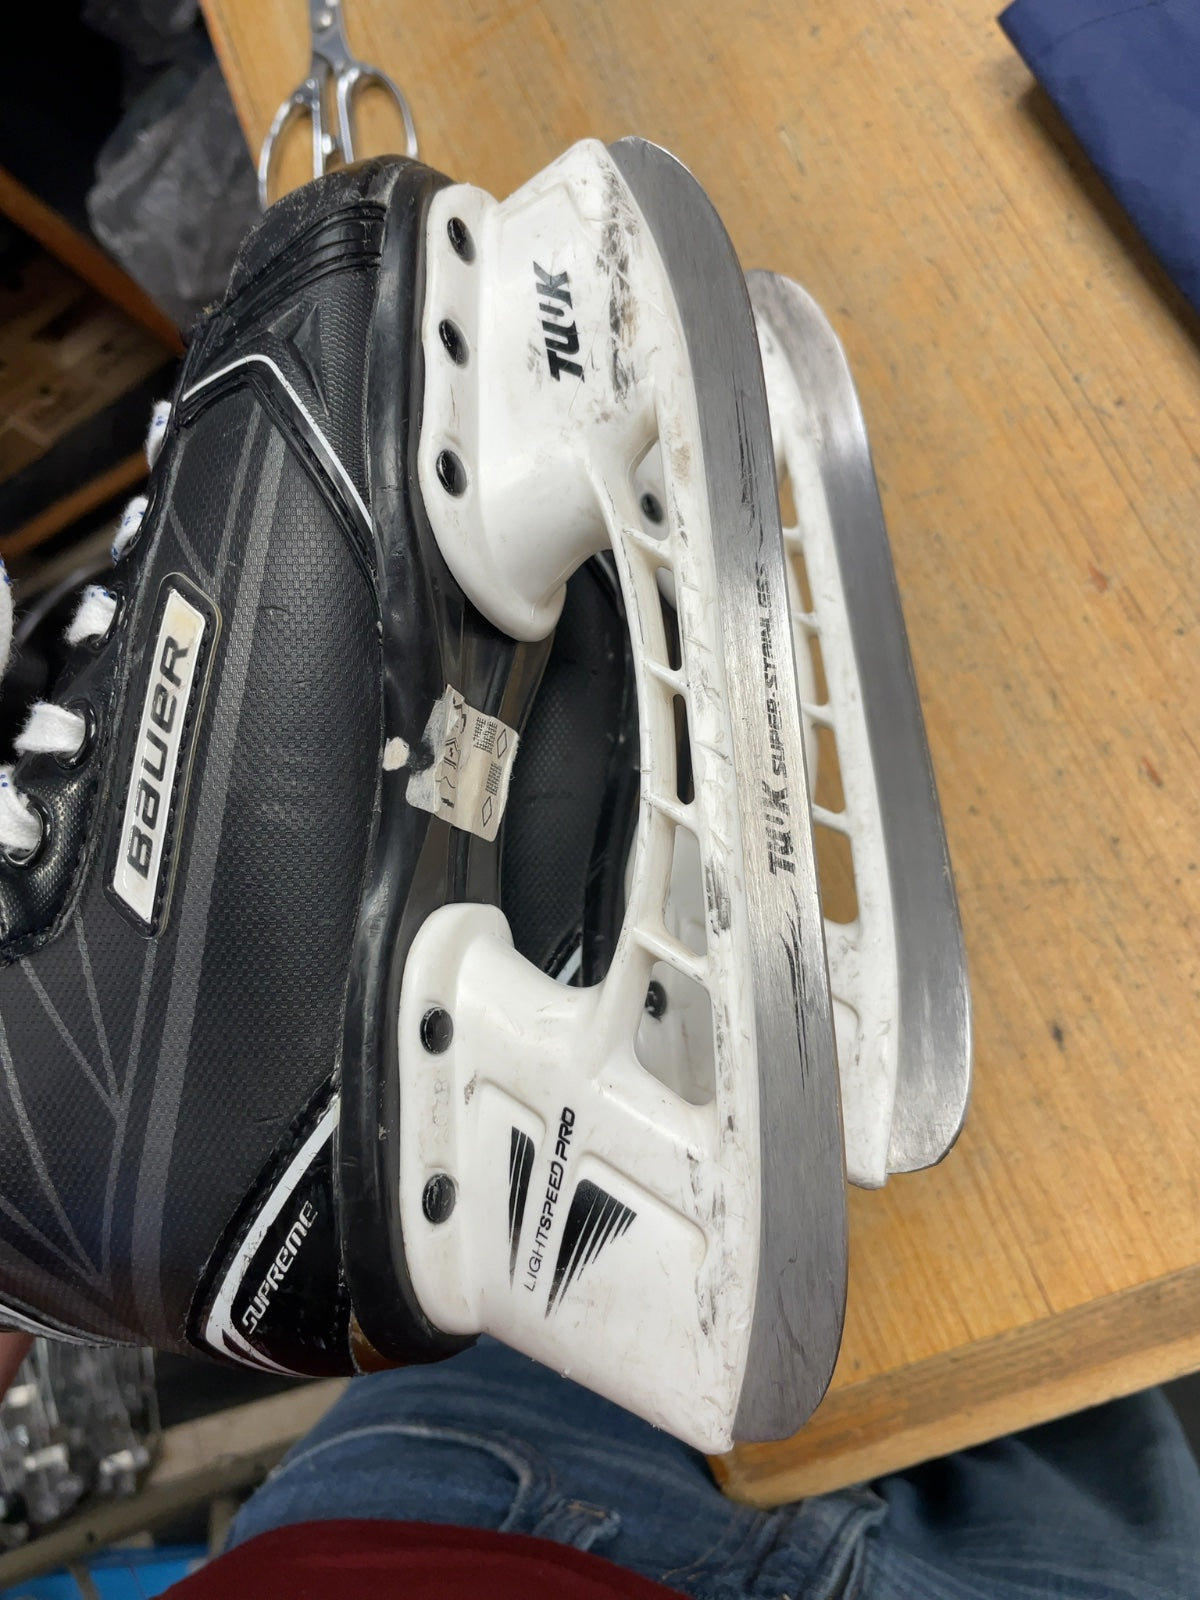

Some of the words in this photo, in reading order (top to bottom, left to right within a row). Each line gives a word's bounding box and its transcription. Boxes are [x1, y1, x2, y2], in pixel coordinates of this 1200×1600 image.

[533, 260, 585, 383] TUUK
[127, 635, 188, 880] BAUER
[762, 780, 796, 877] TUUK
[554, 1106, 576, 1162] PRO
[242, 1200, 318, 1334] SUPREME
